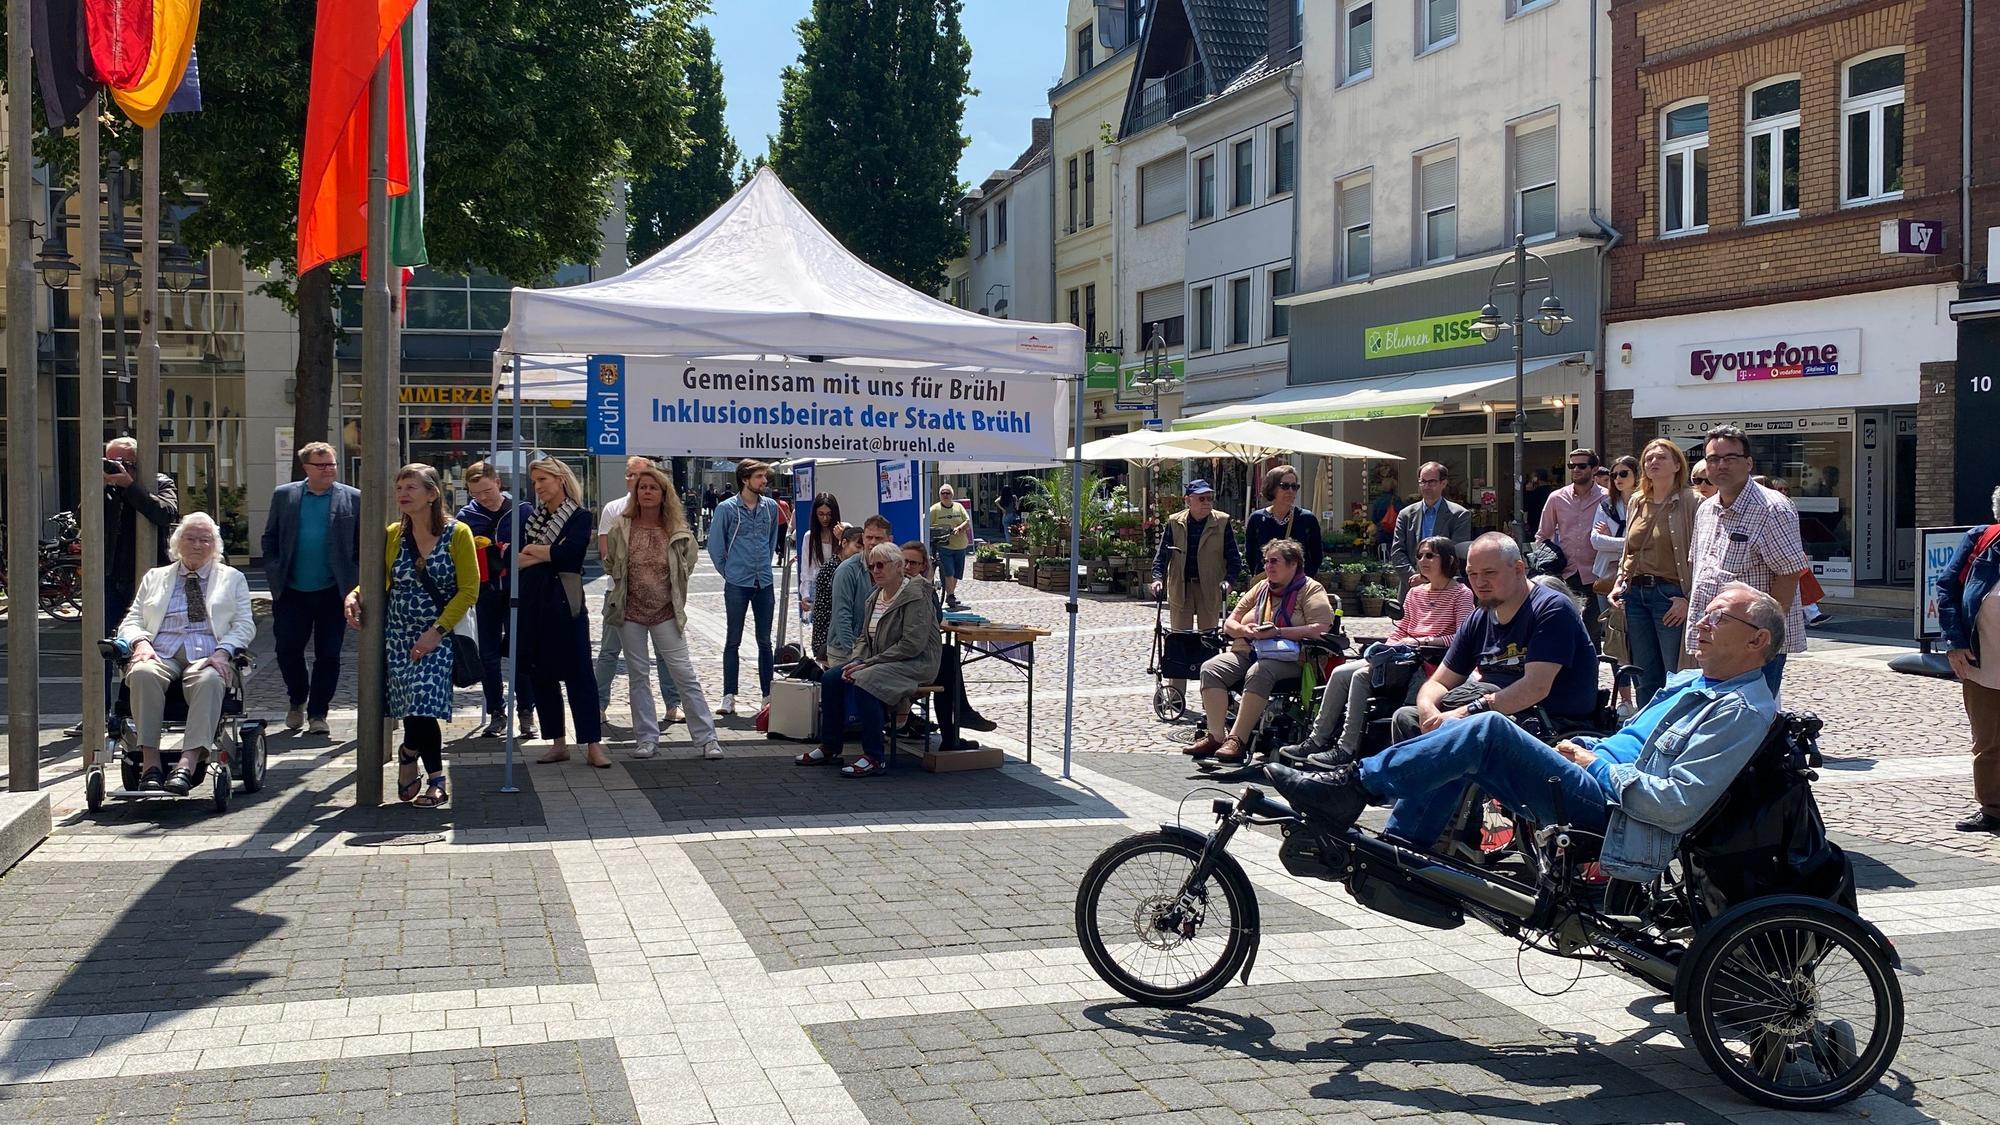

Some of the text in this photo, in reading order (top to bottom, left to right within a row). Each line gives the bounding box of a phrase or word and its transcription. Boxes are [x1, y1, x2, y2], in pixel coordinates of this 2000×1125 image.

[1385, 327, 1430, 350] Blumen
[1703, 341, 1838, 381] yourfone
[683, 366, 1006, 402] Gemeinsam mit uns für Brühl
[1935, 382, 1946, 395] 12
[1970, 375, 1992, 393] 10
[598, 392, 620, 446] Brühl
[652, 398, 1031, 434] Inklusionsbeirat der Stadt Brühl
[740, 432, 956, 453] inklusionsbeirat@bruehl.de
[1588, 931, 1627, 953] HASE
